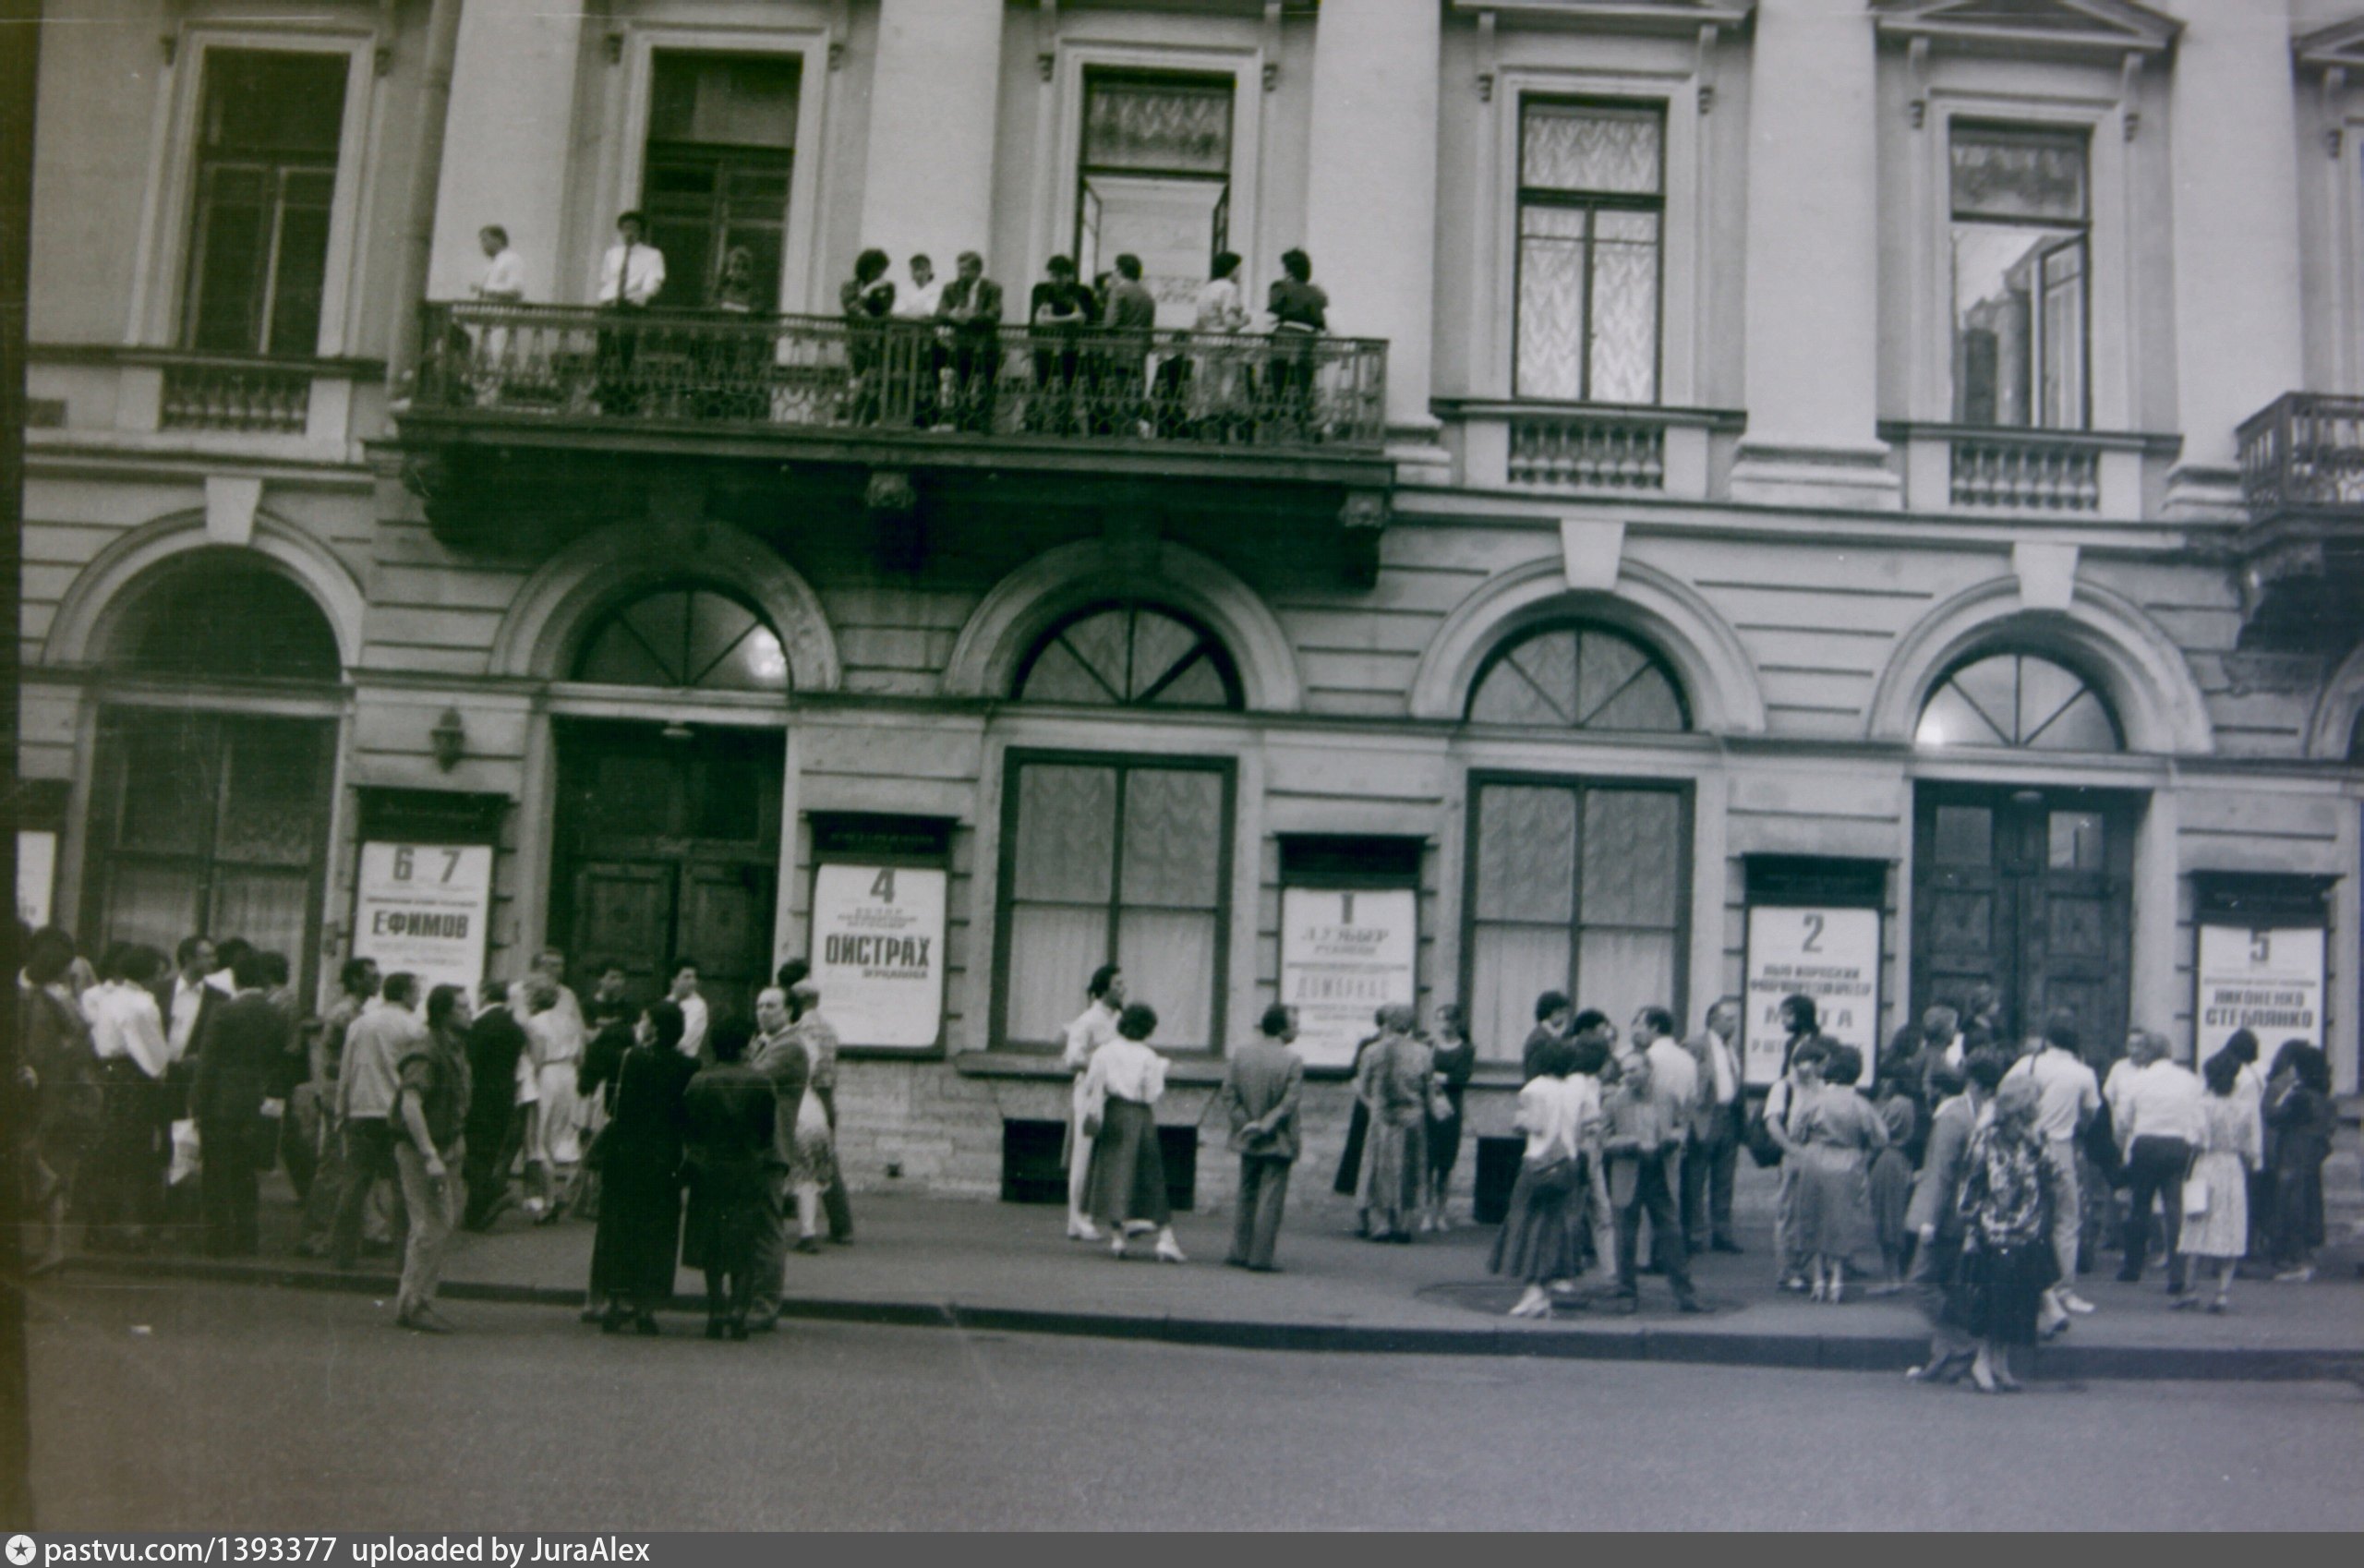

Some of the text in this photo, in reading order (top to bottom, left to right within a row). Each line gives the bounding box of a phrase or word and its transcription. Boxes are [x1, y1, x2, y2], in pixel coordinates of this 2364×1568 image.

[393, 845, 462, 883] 6 7
[870, 867, 896, 904] 4
[372, 909, 469, 939] ЕФИМОВ
[1802, 913, 1825, 952] 2
